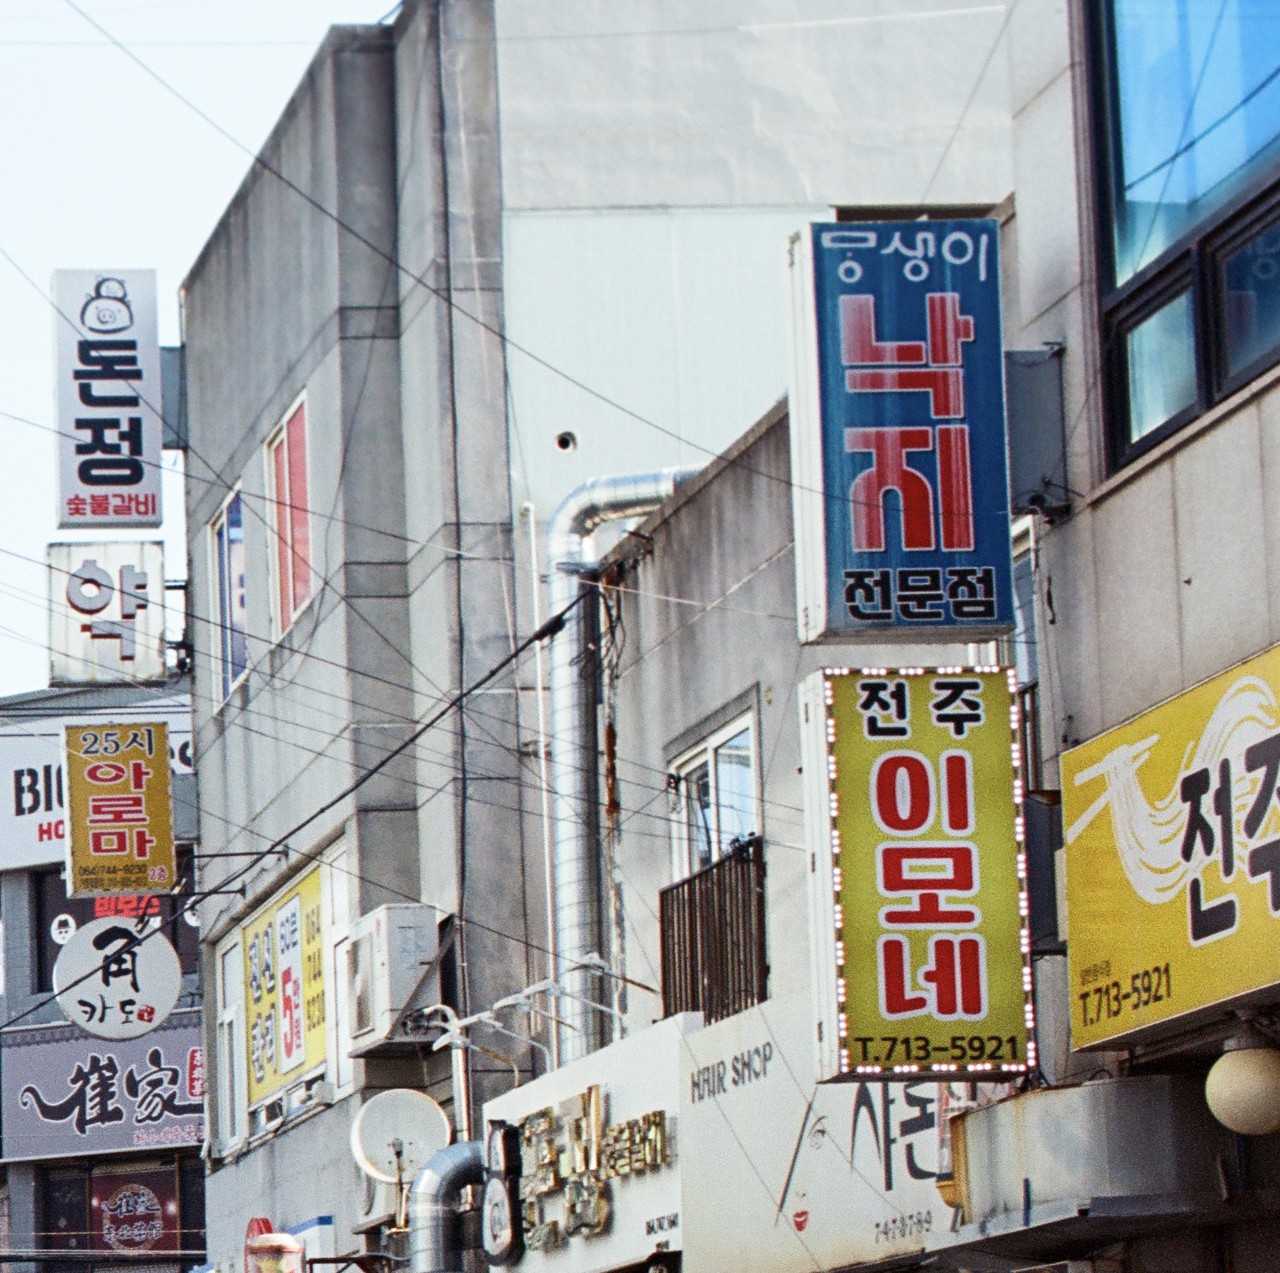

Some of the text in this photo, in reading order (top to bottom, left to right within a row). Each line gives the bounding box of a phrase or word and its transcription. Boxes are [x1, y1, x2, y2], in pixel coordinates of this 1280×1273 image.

[72, 338, 145, 487] 돈정
[839, 292, 975, 553] 낙지
[66, 492, 156, 517] 숯불갈비
[65, 558, 148, 661] 약
[842, 565, 998, 622] 전문점
[858, 679, 986, 741] 전주
[81, 728, 155, 756] 25시
[83, 760, 157, 861] 아로마
[149, 866, 168, 882] 2층
[868, 749, 989, 1022] 이모네
[77, 995, 137, 1025] 카도
[1080, 962, 1173, 1028] T.713-5921
[690, 1041, 774, 1104] HAIR SHOP
[854, 1036, 1020, 1063] T.713-5921
